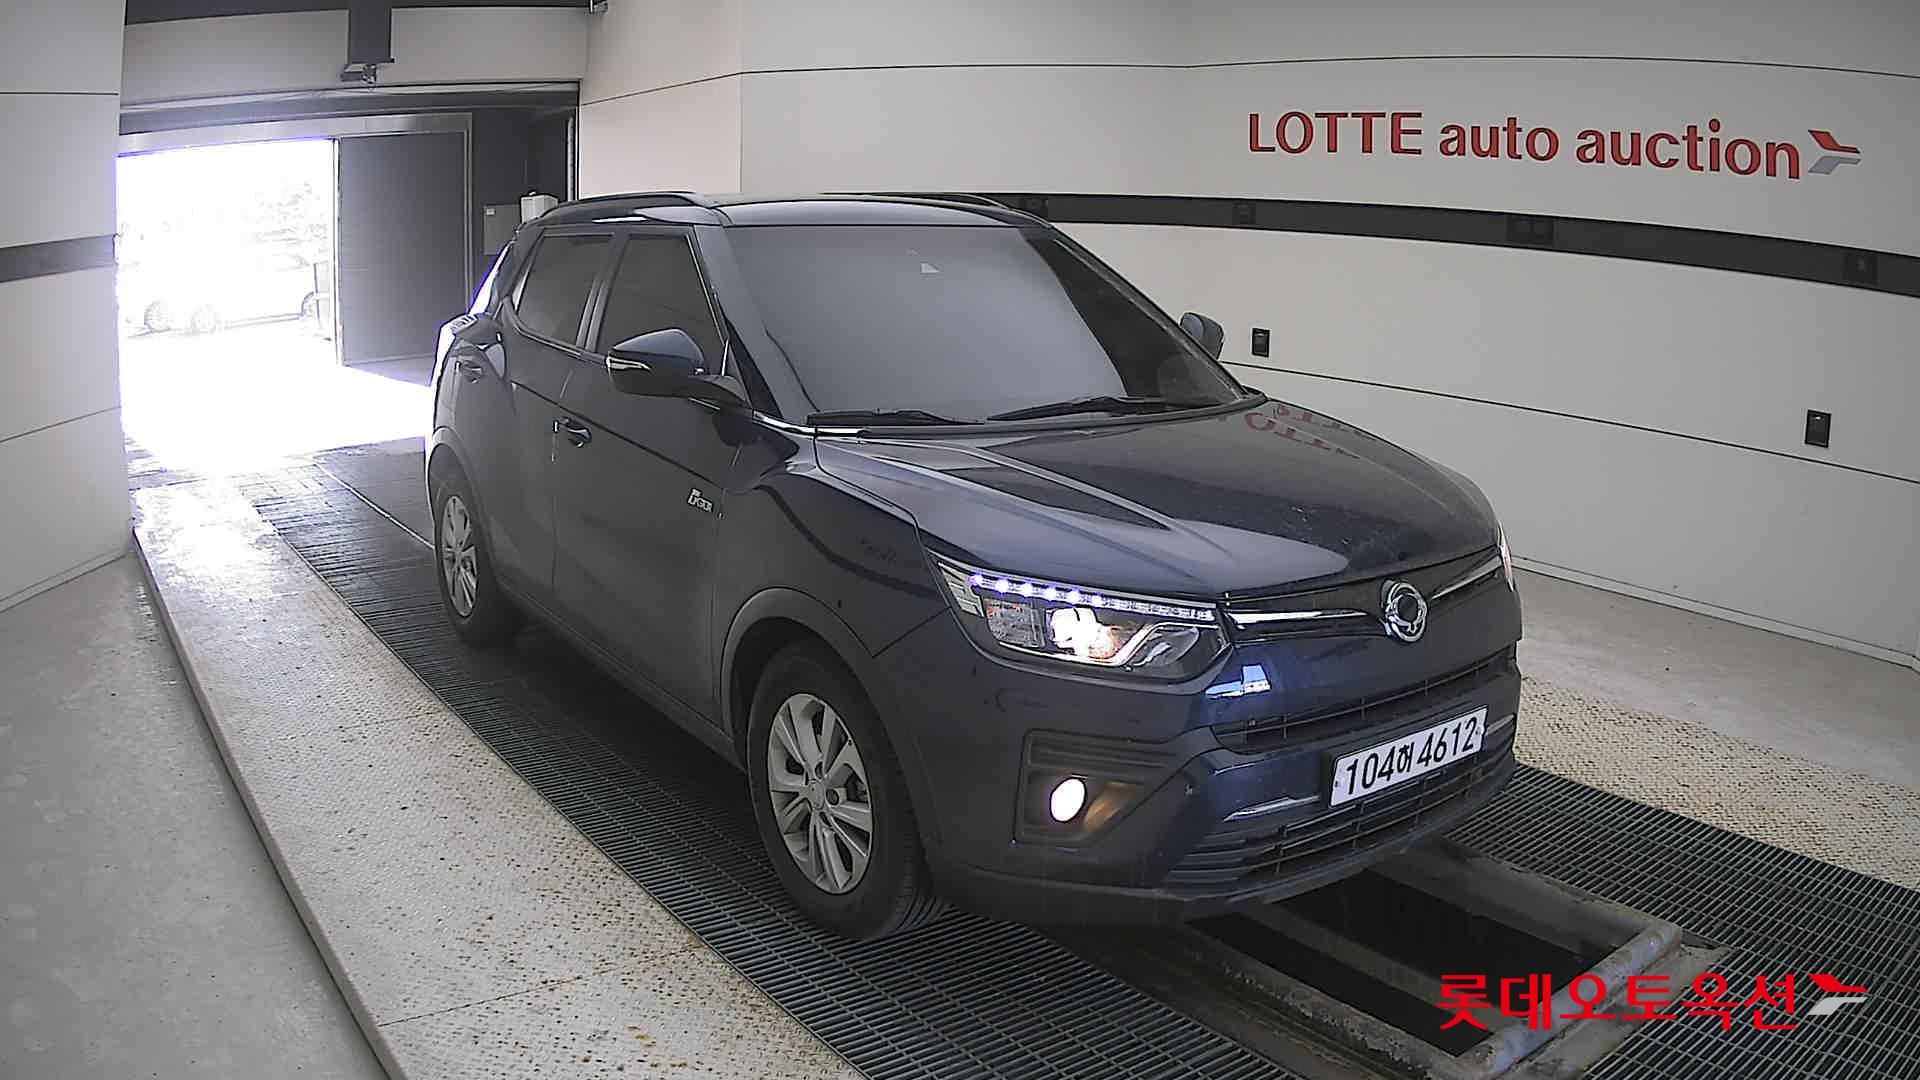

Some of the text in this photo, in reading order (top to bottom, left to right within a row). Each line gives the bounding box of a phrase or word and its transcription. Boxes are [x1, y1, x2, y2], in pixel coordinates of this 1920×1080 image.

[1249, 112, 1801, 178] LOTTE auto auction
